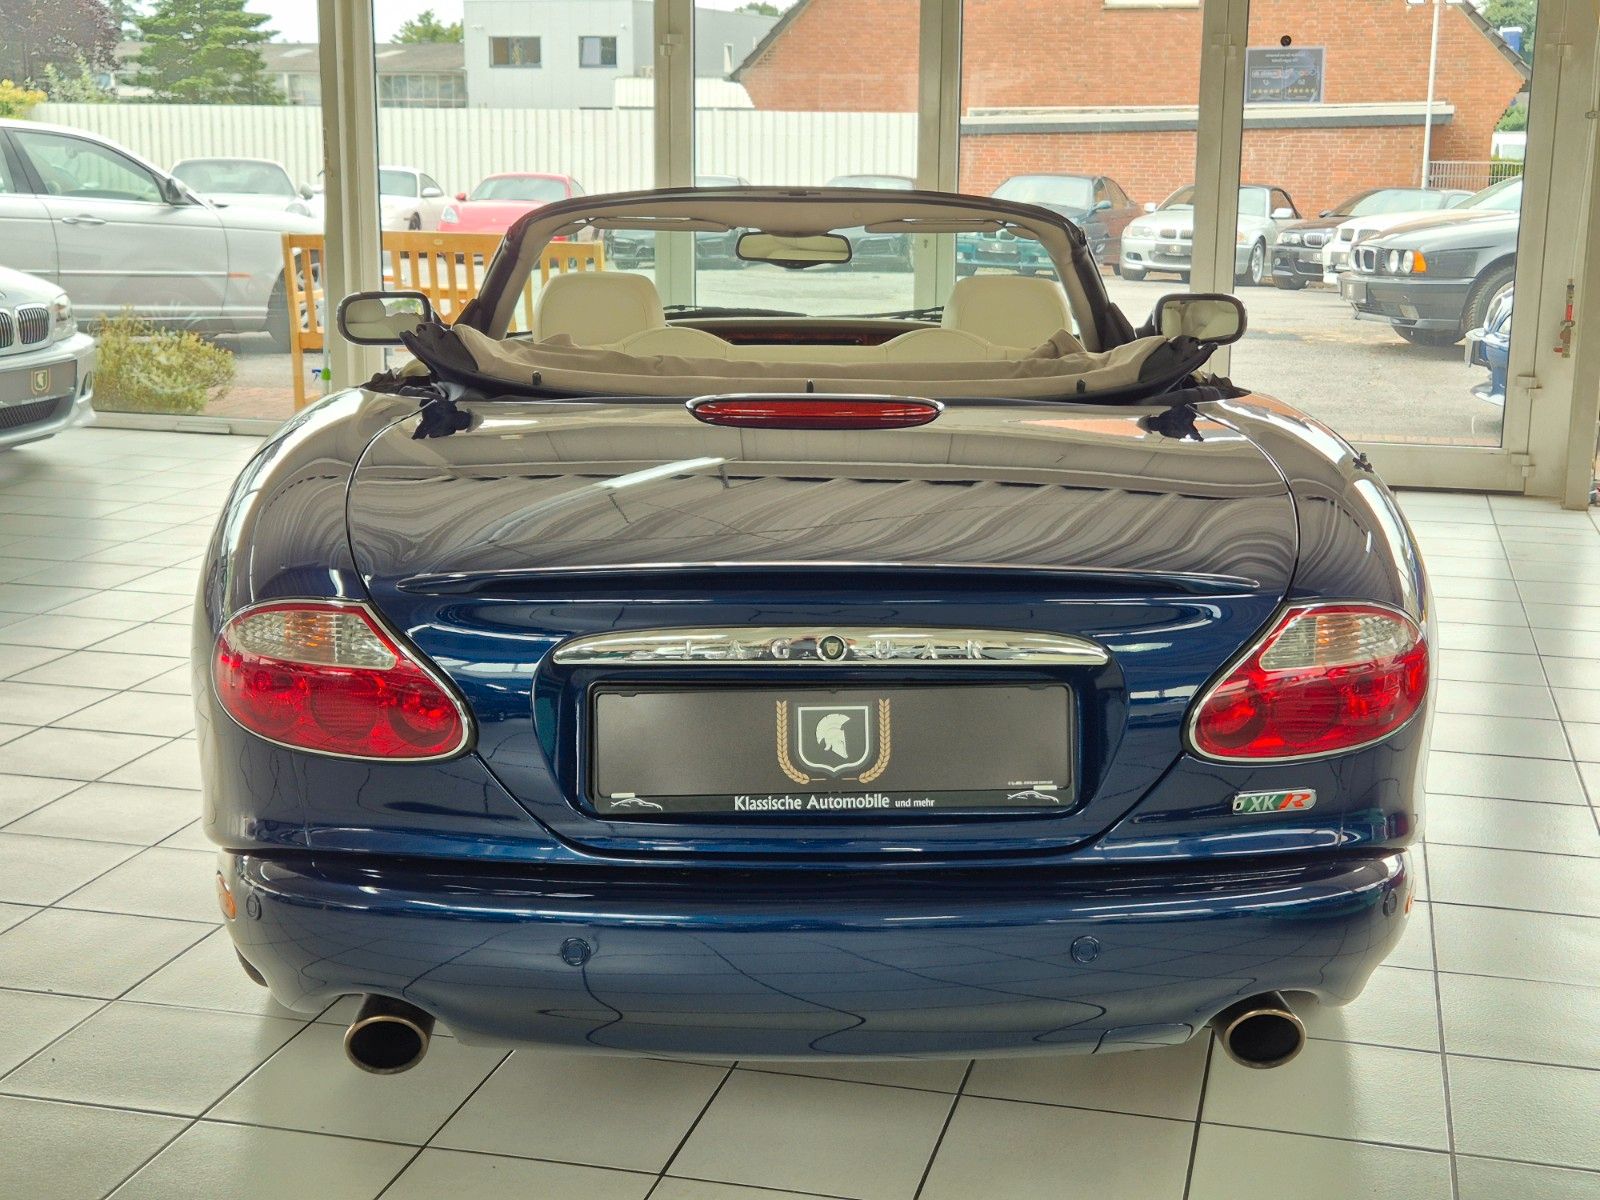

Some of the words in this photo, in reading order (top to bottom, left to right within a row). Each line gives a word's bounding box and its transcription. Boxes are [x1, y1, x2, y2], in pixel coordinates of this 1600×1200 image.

[734, 795, 802, 811] Klassische
[806, 793, 890, 810] Automobile
[895, 799, 911, 808] und
[913, 798, 936, 807] mehr
